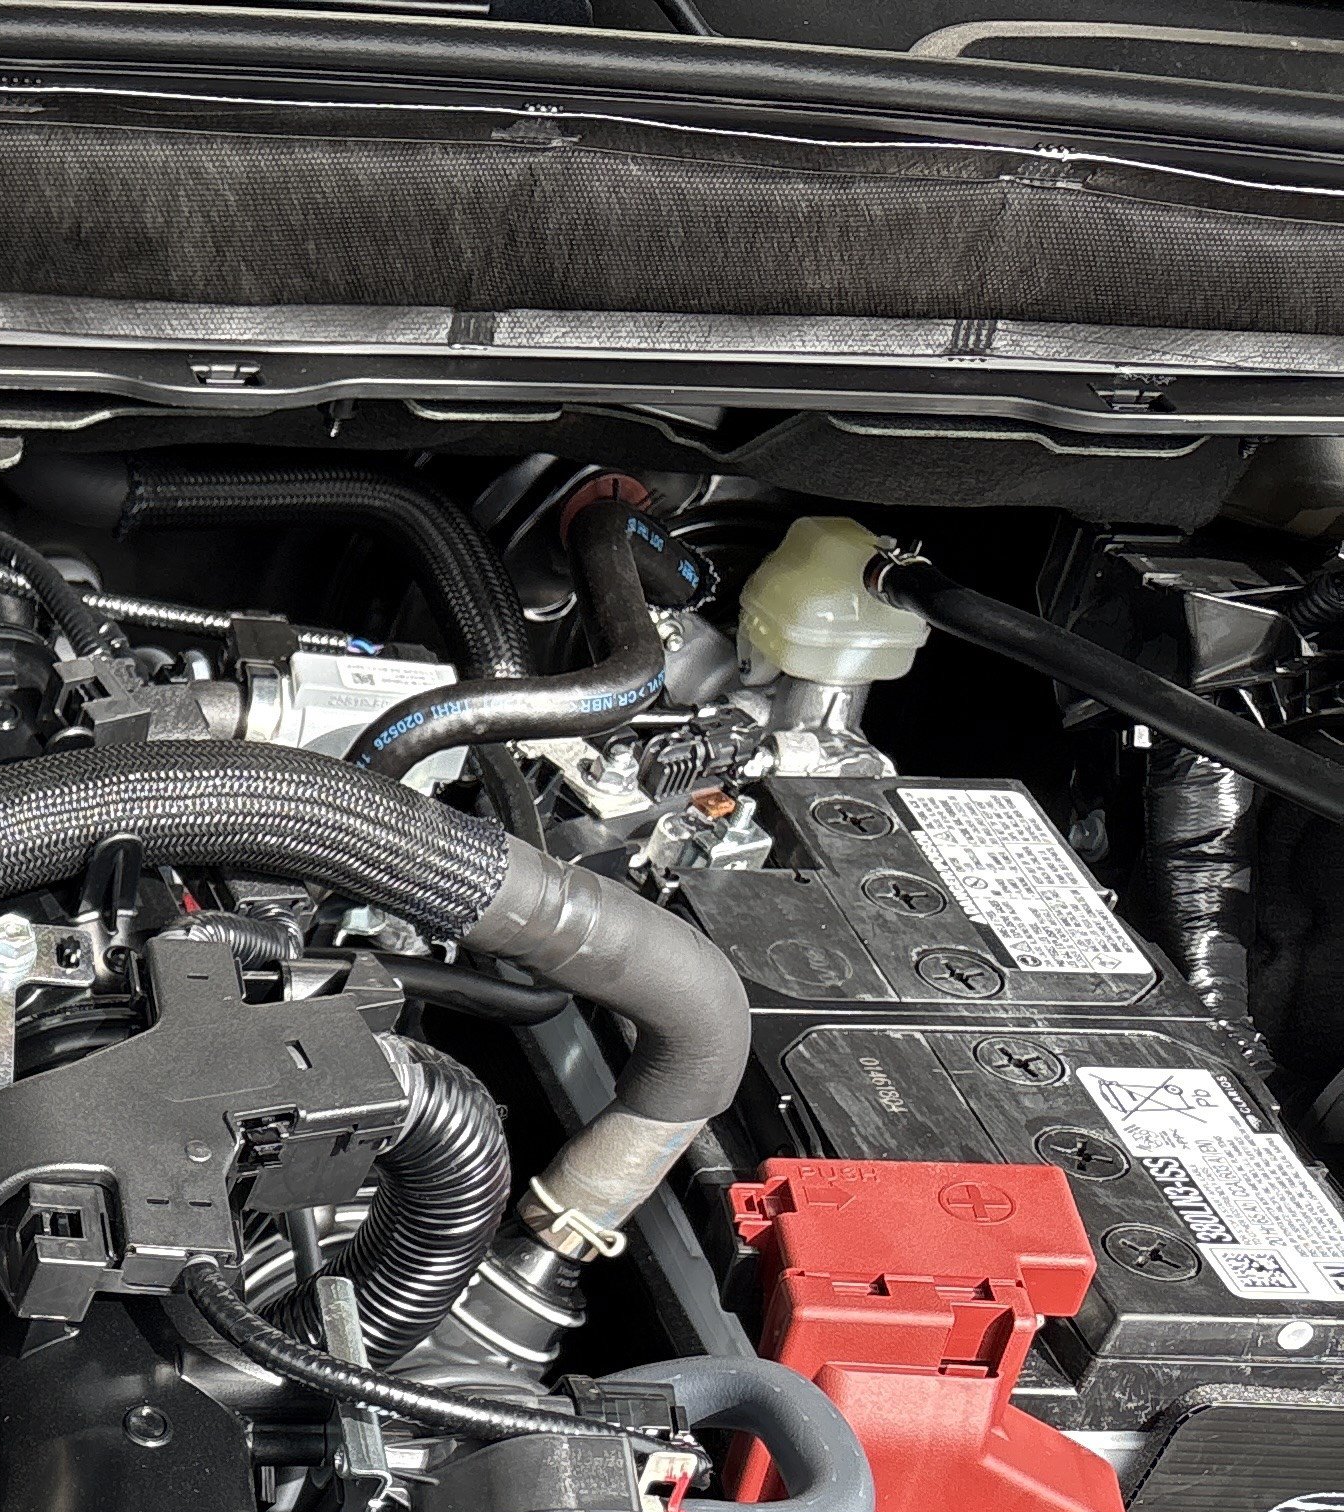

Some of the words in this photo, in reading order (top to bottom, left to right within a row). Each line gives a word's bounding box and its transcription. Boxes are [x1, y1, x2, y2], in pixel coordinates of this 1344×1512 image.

[372, 711, 425, 751] 020526
[1191, 1088, 1219, 1107] Pb
[1216, 1075, 1252, 1114] CLARIOS
[797, 1165, 881, 1183] PUSH
[1142, 1157, 1233, 1242] 380LN3-ISS
